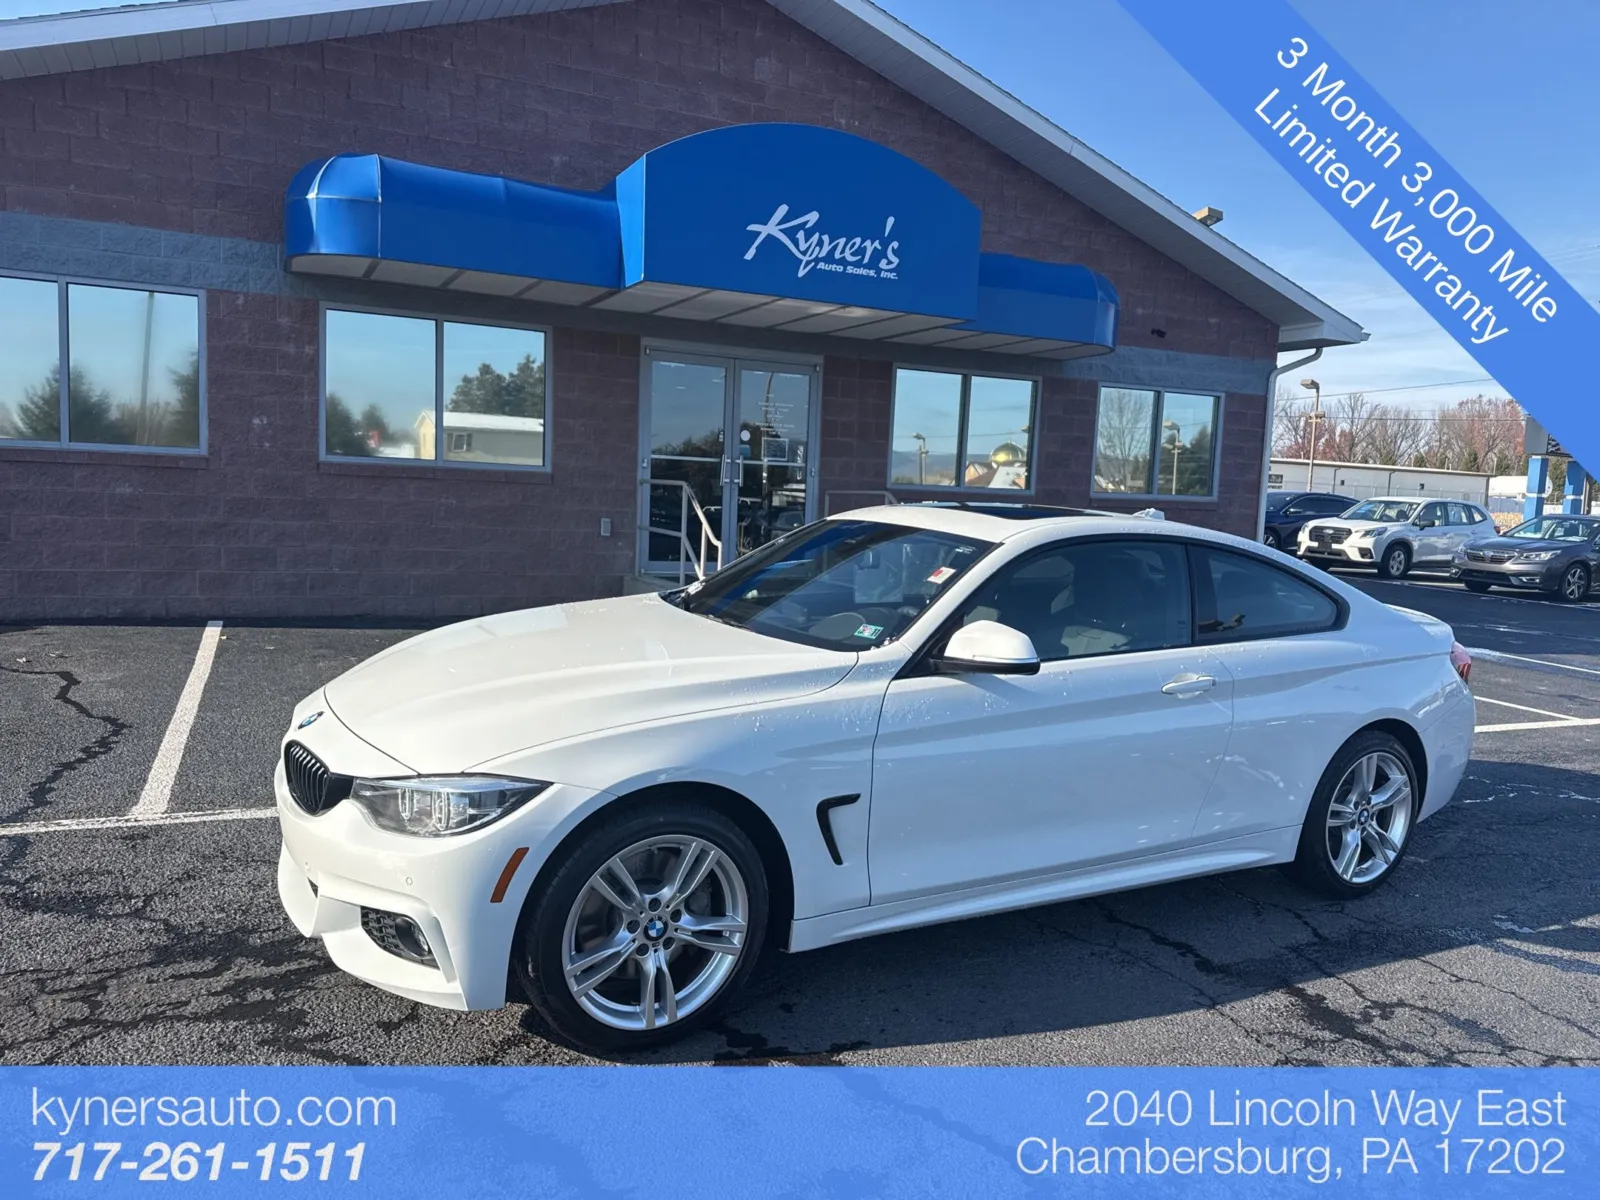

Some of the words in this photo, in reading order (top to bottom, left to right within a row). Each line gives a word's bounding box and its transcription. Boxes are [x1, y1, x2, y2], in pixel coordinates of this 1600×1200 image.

[743, 204, 900, 278] Kyner's
[816, 262, 844, 272] Auto
[846, 265, 877, 277] Sales,
[880, 270, 898, 279] Inc.
